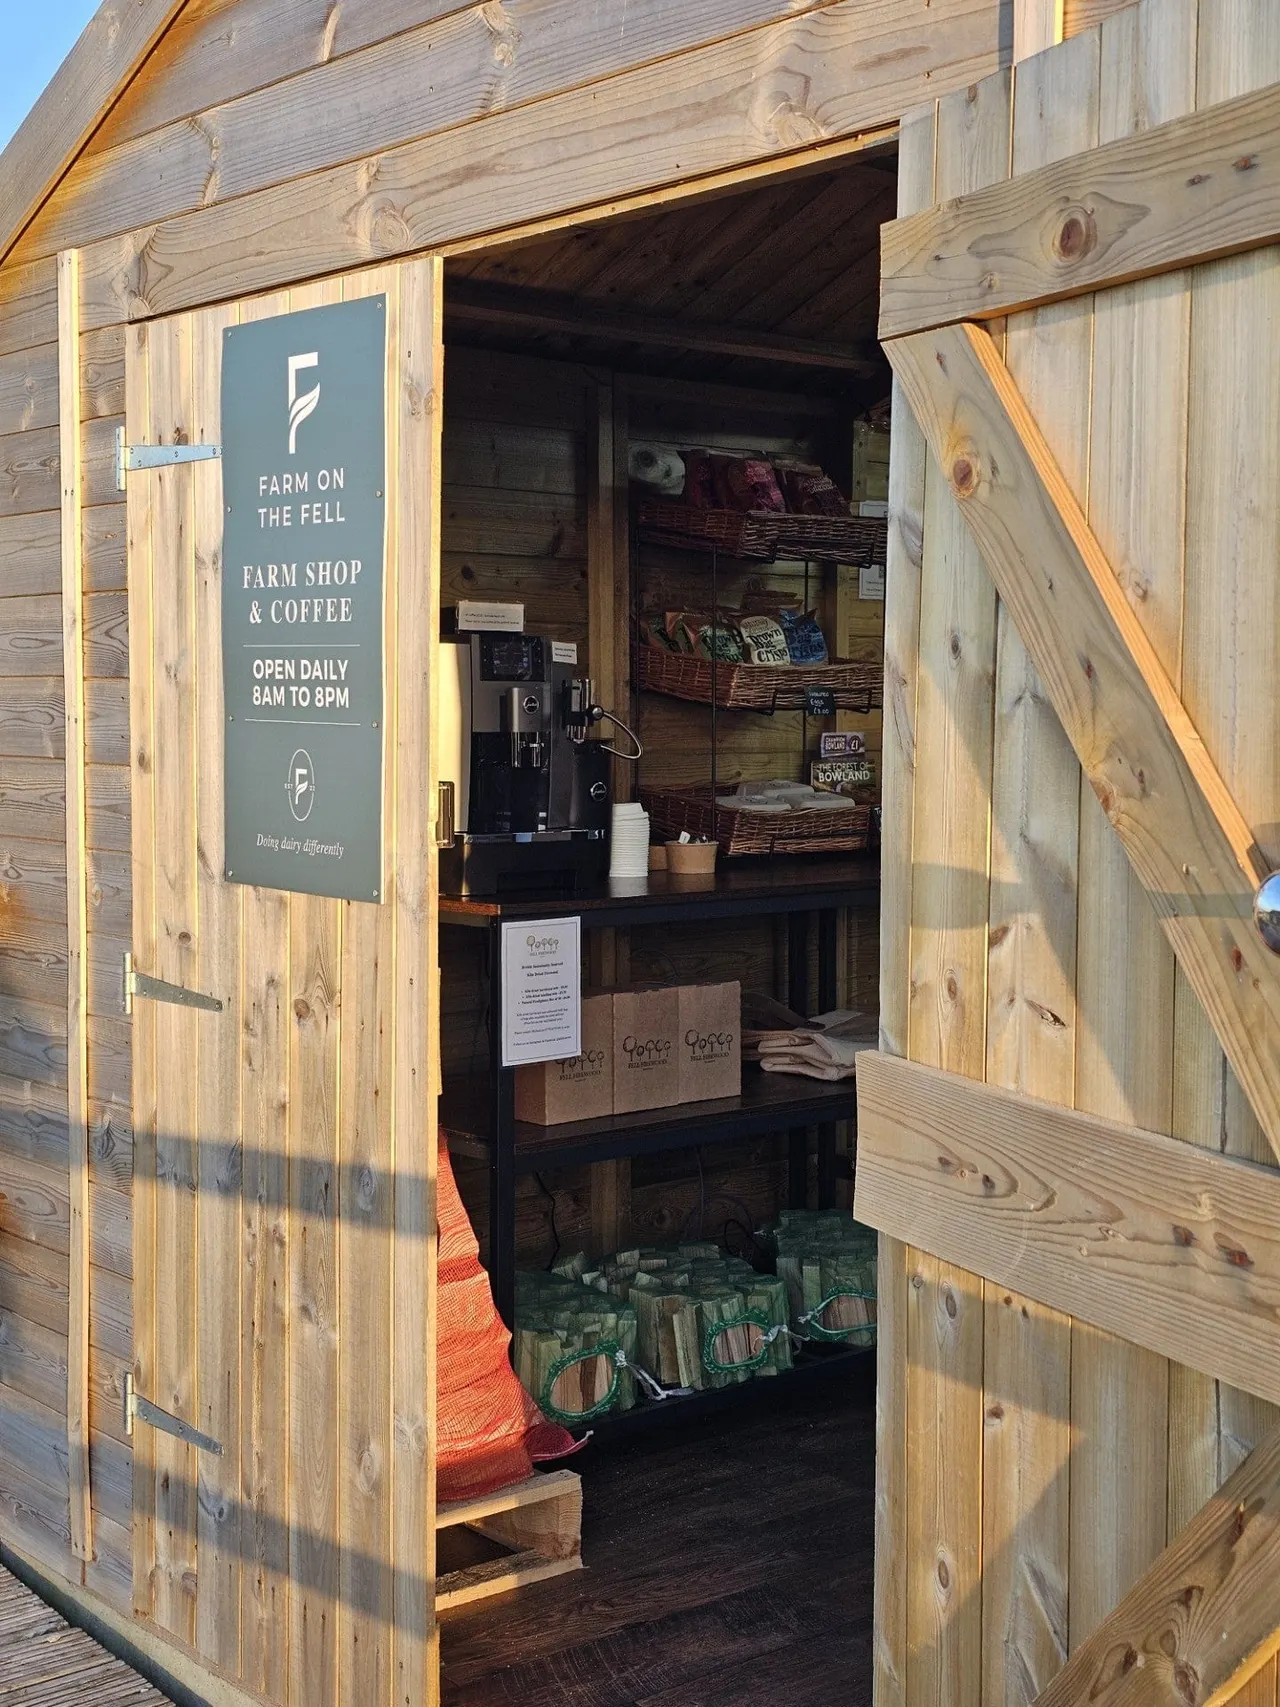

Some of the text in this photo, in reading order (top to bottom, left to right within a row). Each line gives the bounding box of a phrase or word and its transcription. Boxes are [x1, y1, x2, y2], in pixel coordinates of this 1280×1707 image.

[259, 467, 344, 496] FARM ON
[258, 501, 345, 528] THE FELL
[242, 560, 362, 588] FARM SHOP
[249, 598, 353, 624] & COFFEE
[747, 629, 782, 645] Brown
[757, 646, 788, 663] Crisps
[252, 659, 349, 681] OPEN DAILY
[252, 685, 349, 708] 8AM TO 8PM
[851, 739, 859, 750] £1
[818, 770, 870, 782] BOWLAND
[819, 763, 831, 772] THE
[832, 762, 858, 772] FOREST
[256, 833, 344, 859] Doing dairy differently
